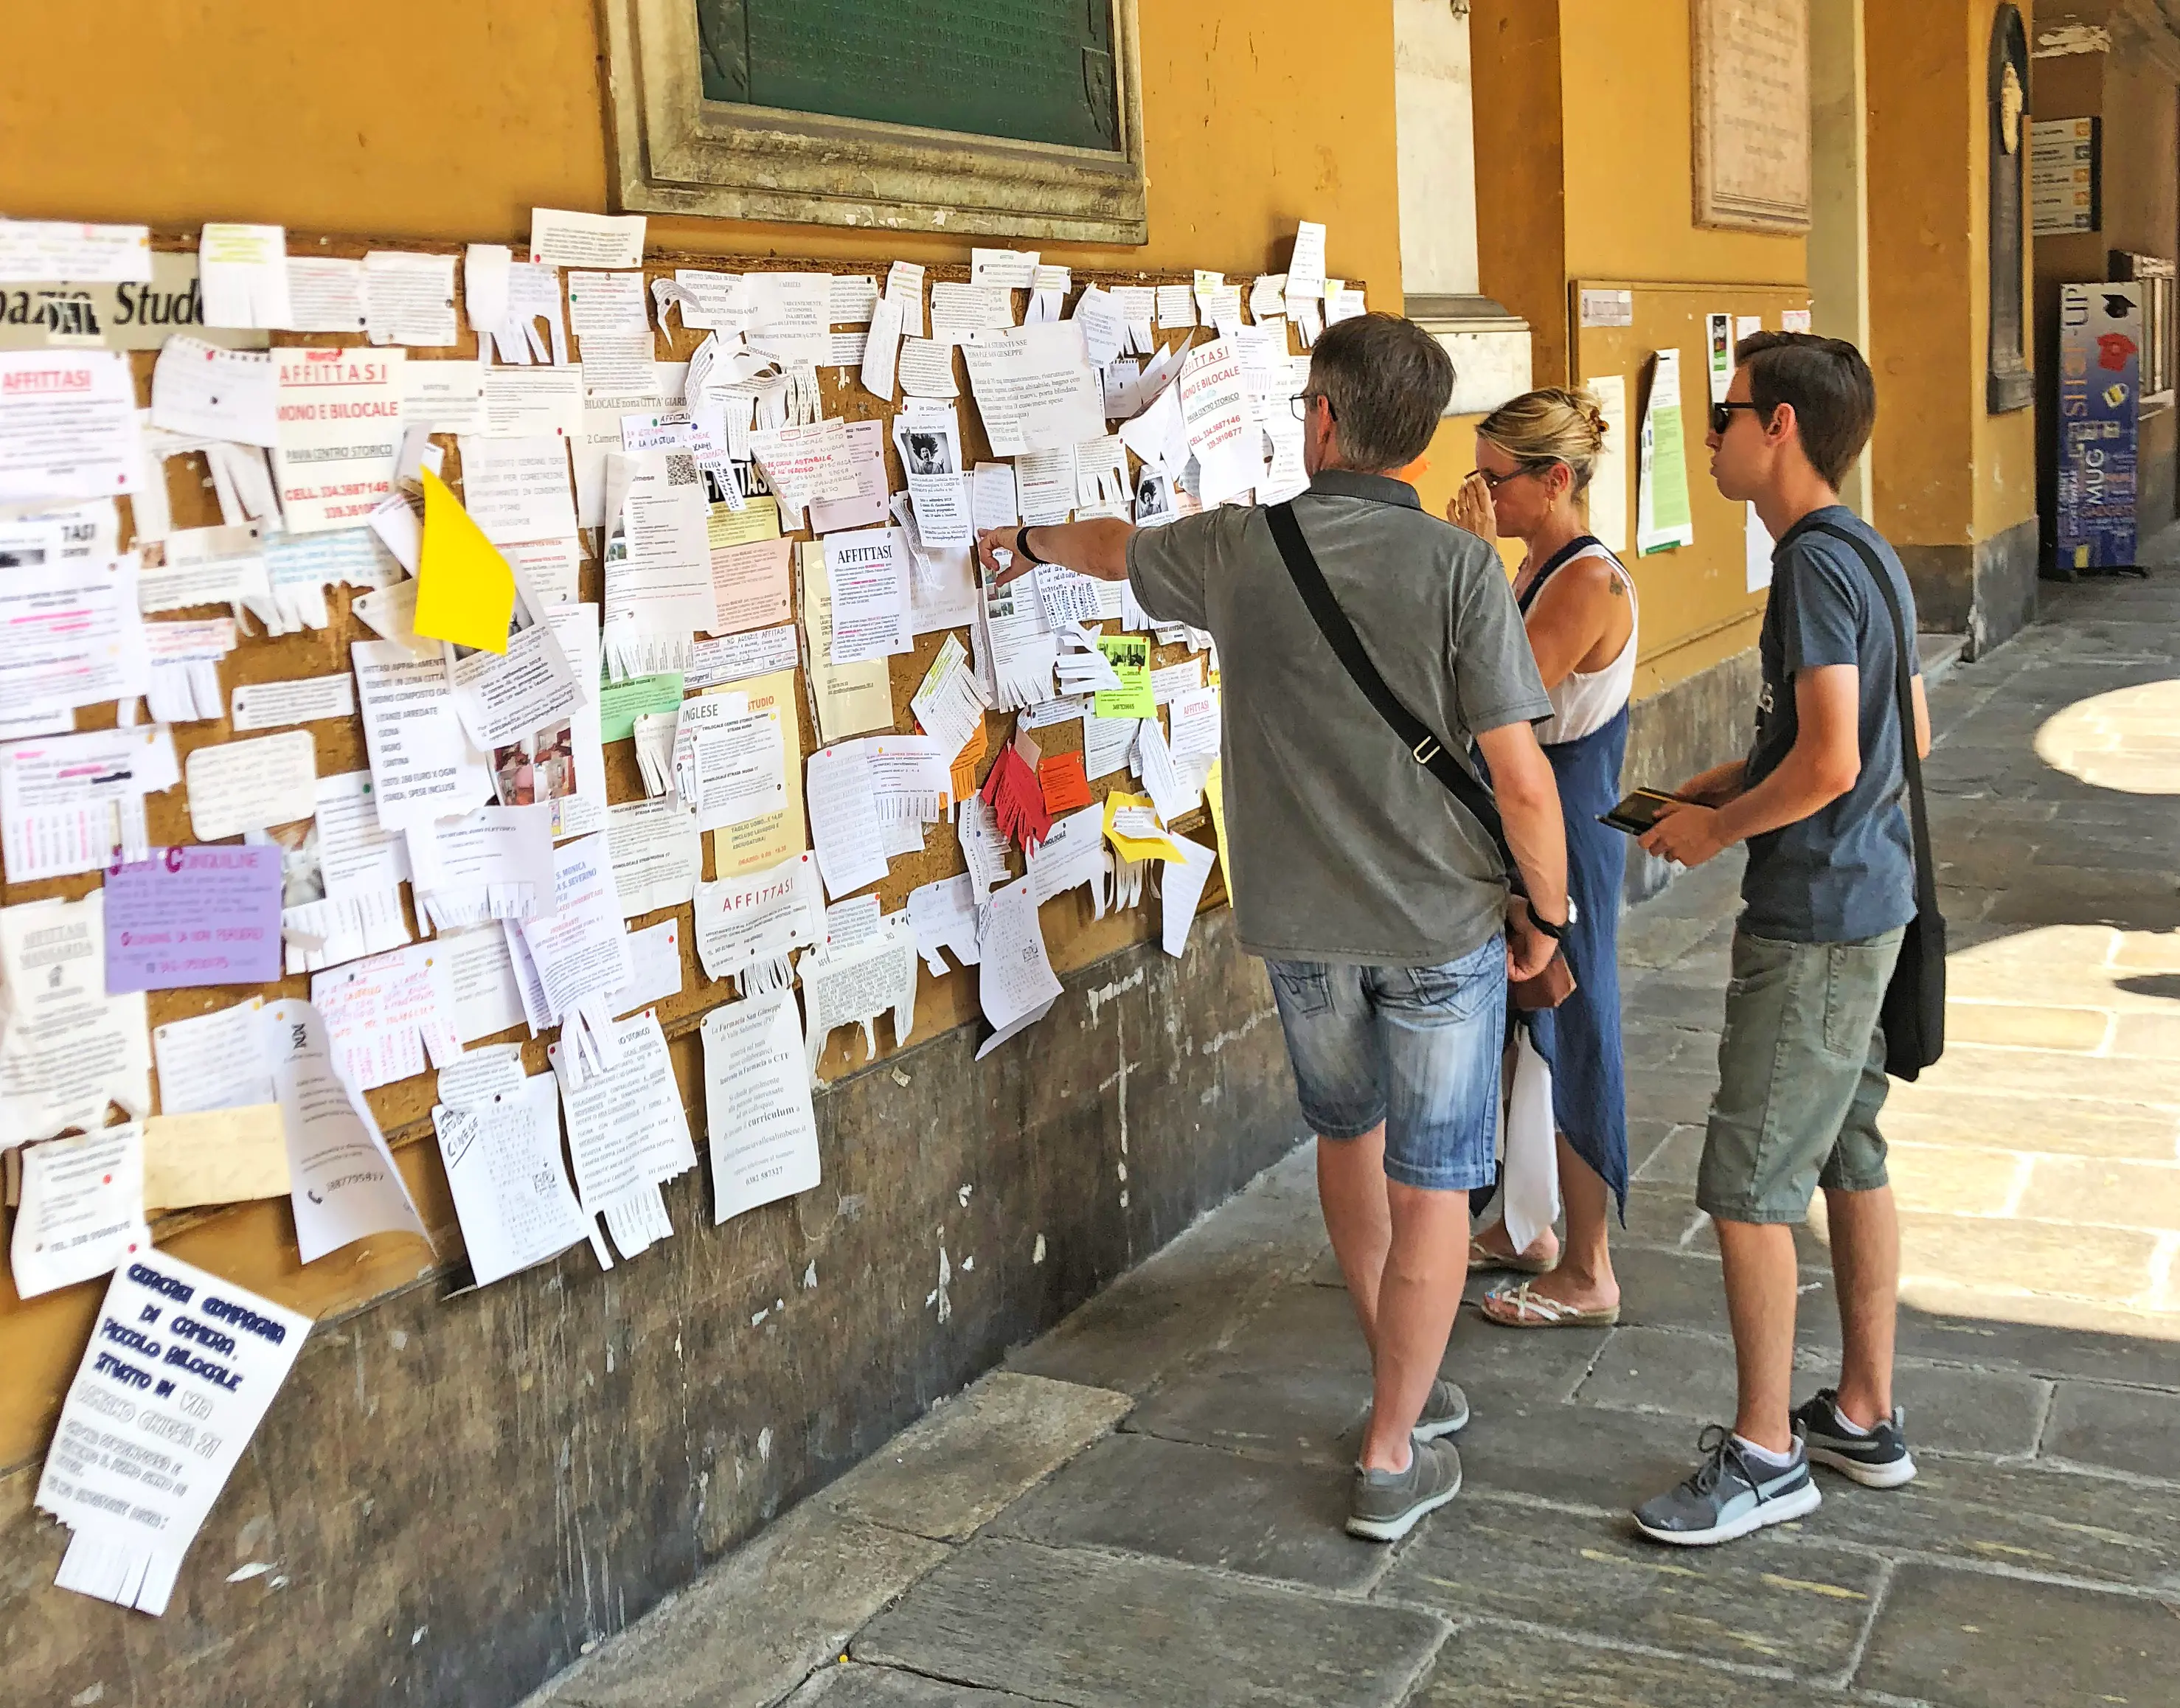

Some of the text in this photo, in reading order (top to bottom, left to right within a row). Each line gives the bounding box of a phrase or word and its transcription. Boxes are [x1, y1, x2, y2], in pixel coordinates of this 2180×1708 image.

[1181, 345, 1229, 378] AFFITTASI
[280, 364, 387, 382] AFFITTASI
[1181, 366, 1240, 400] MONO E BILOCALE
[584, 398, 620, 409] BILOCALE
[1214, 392, 1240, 407] STORICO
[277, 401, 398, 421] MONO E BILOCALE
[587, 434, 591, 443] 2
[2085, 448, 2105, 504] MUG
[837, 545, 892, 564] AFFITTASI
[682, 704, 718, 723] INGLESE
[723, 877, 794, 912] AFFITTASI
[719, 1016, 746, 1032] Farmacia
[746, 1013, 757, 1021] San
[748, 1105, 795, 1128] curriculum
